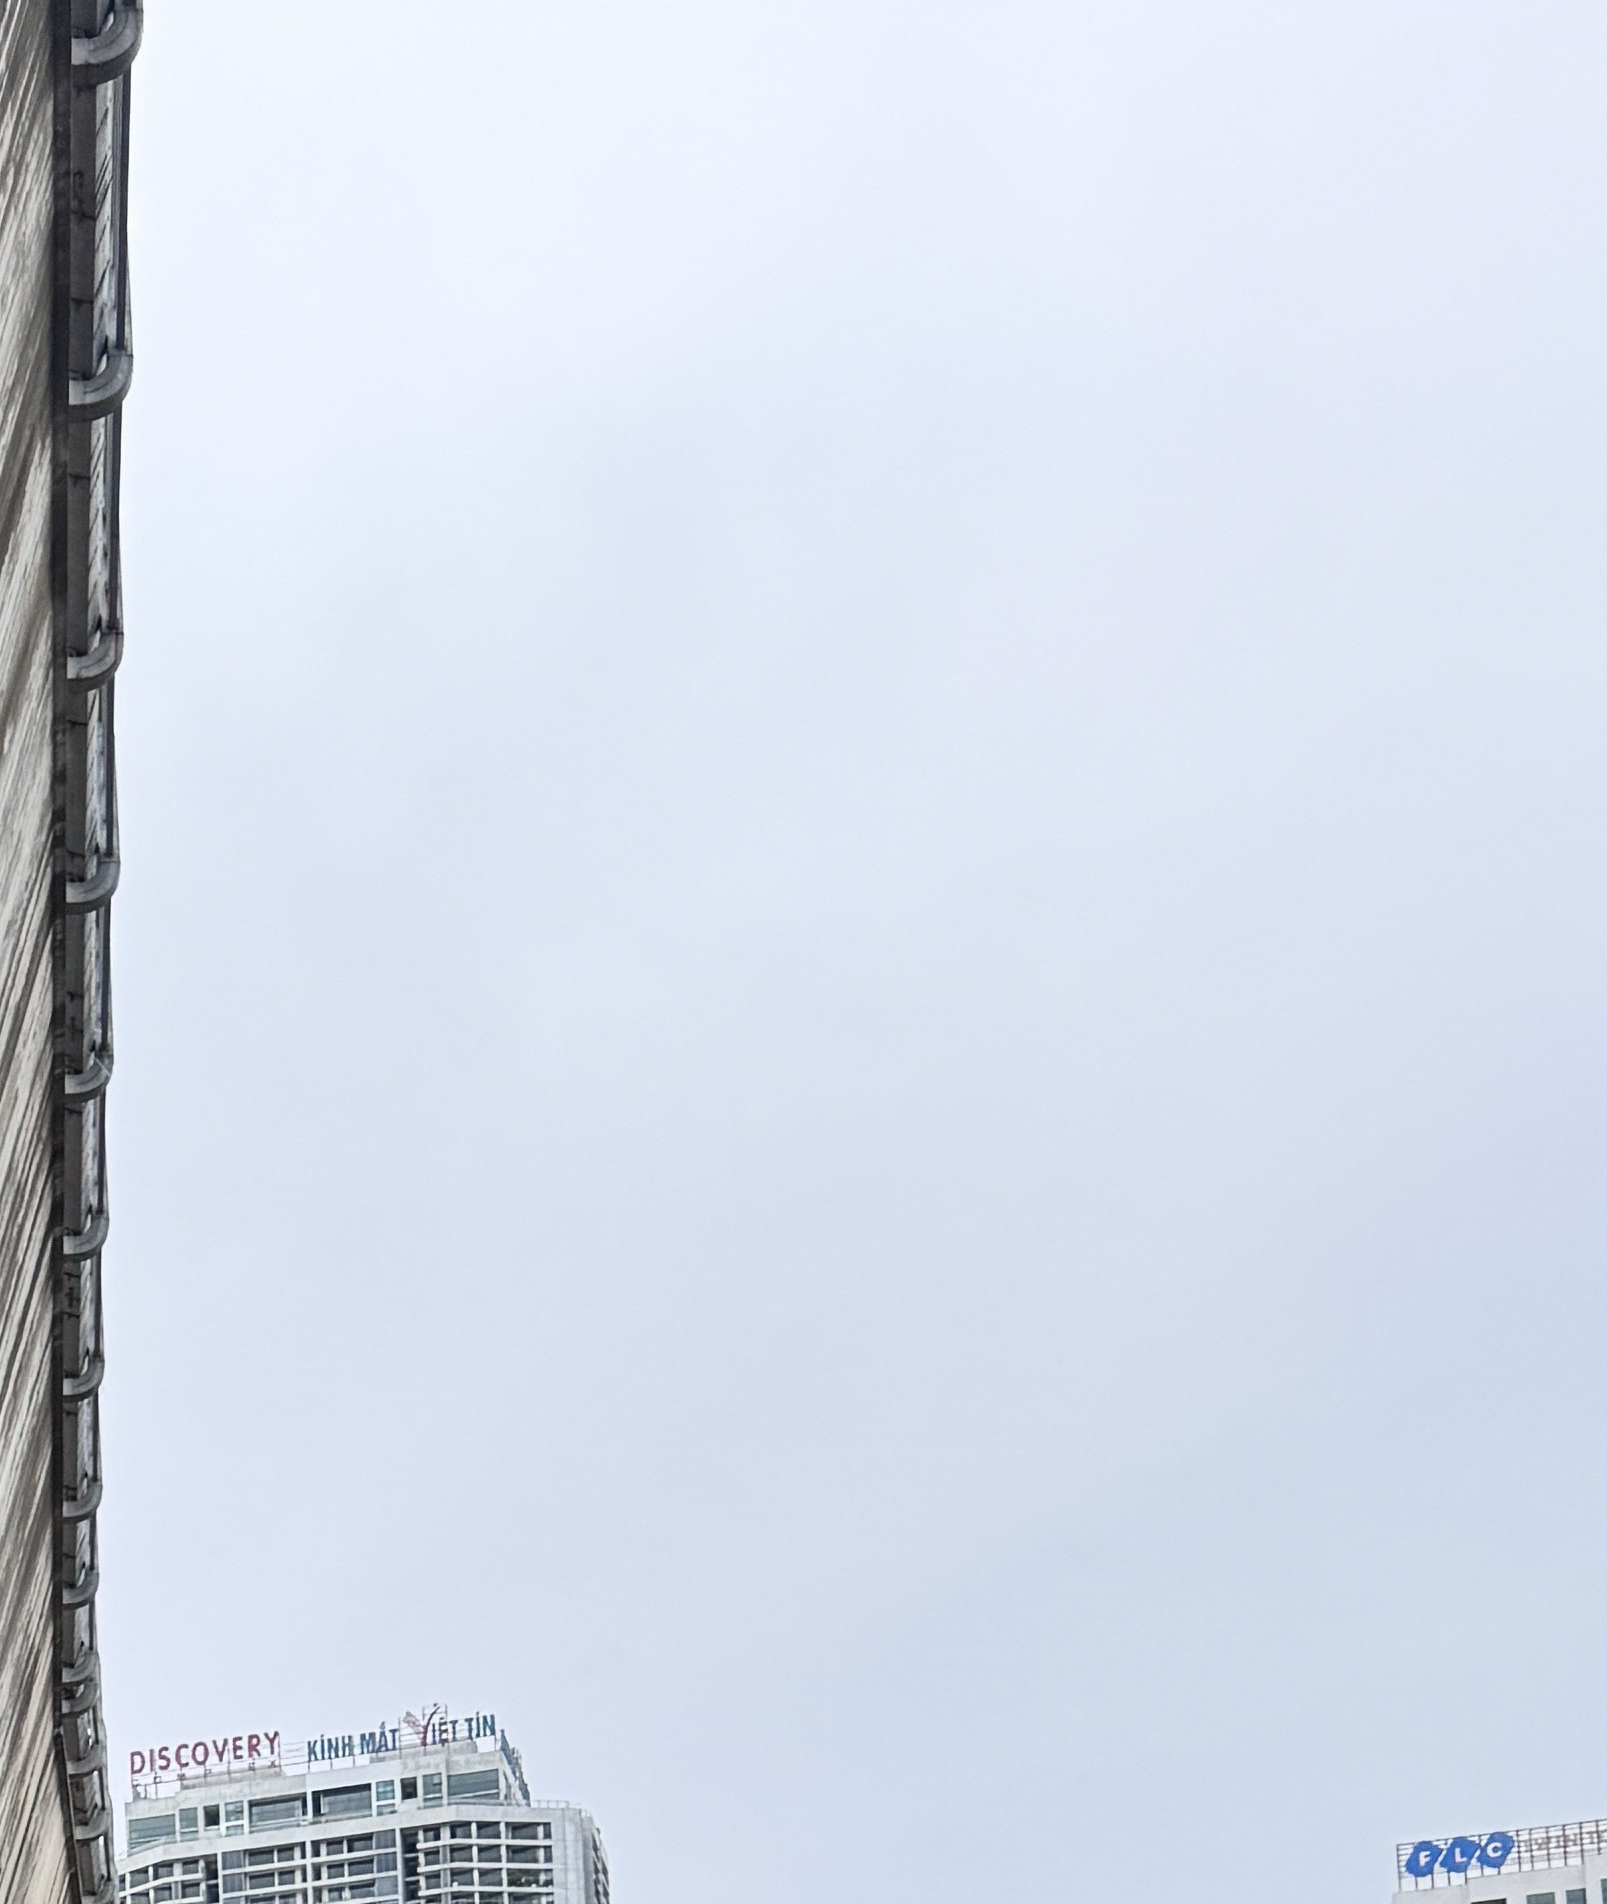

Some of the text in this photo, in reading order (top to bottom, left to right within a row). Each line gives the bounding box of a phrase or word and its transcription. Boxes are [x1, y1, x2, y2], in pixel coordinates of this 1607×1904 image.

[130, 1730, 280, 1775] DISCOVERY
[307, 1734, 355, 1762] KÍNH
[359, 1720, 400, 1755] MẮT
[465, 1711, 496, 1740] TÍN
